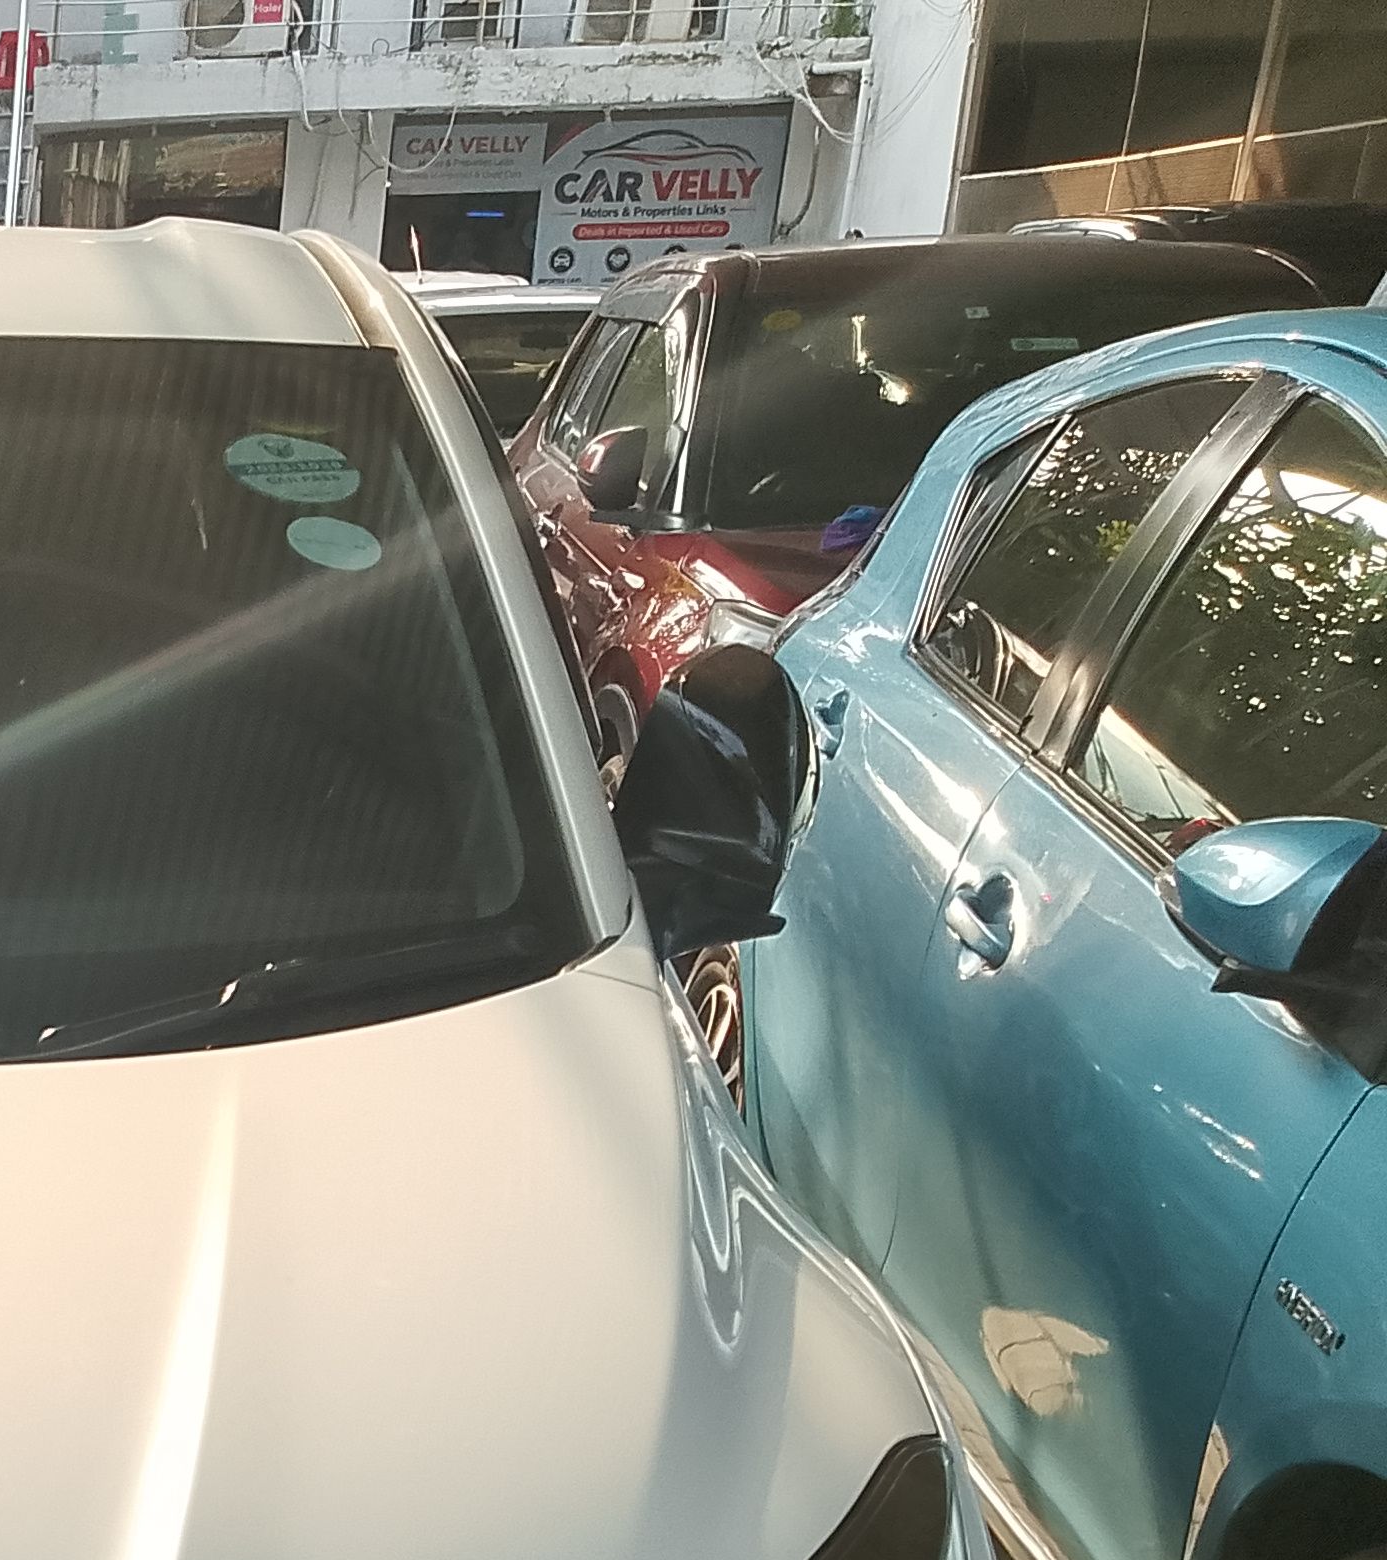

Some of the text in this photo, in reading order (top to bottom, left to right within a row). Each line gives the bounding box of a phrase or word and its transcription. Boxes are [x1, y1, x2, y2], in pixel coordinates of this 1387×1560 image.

[254, 2, 282, 13] Haier
[406, 136, 530, 155] CAR VELLY
[555, 167, 764, 204] CAR VELLY
[581, 205, 726, 219] Motors & Properties Links
[579, 227, 605, 237] Deals
[618, 225, 662, 238] Imported
[701, 223, 725, 234] Cars
